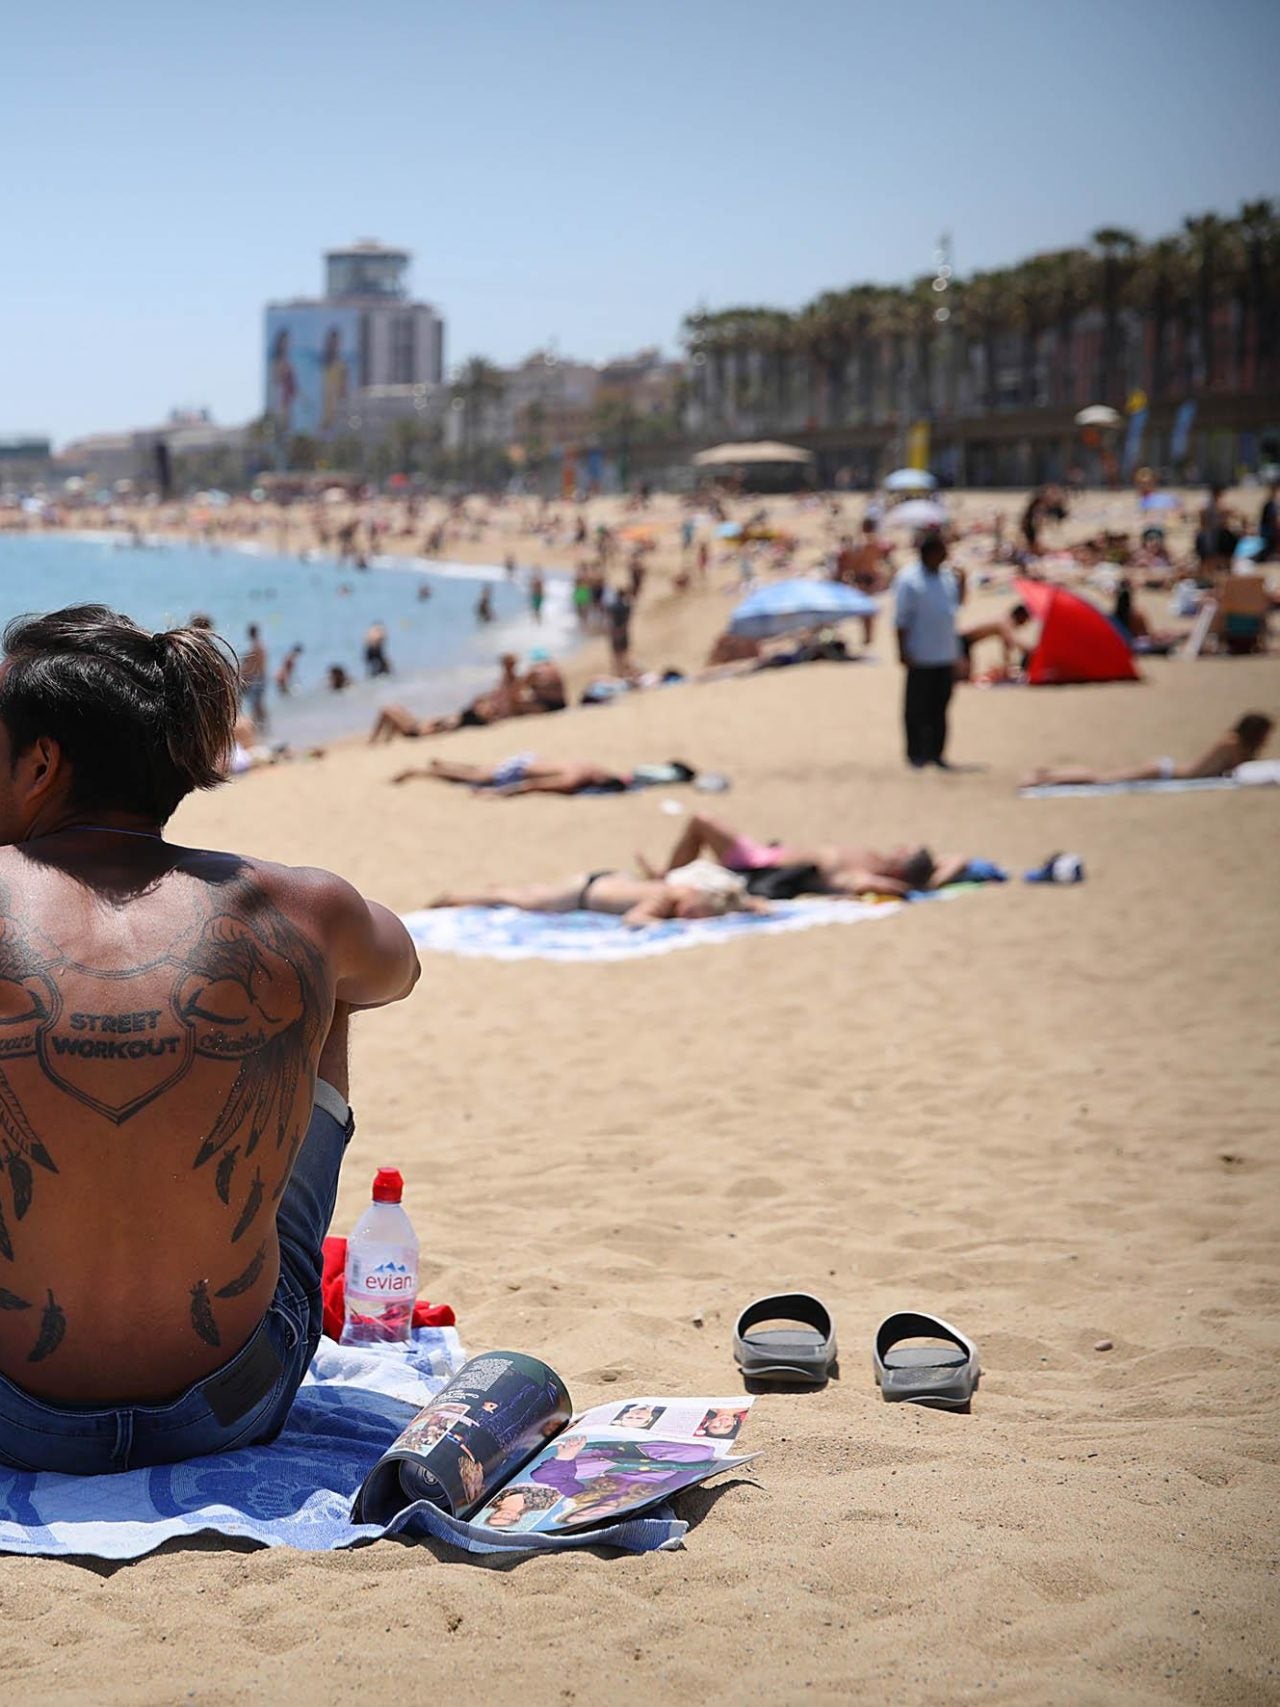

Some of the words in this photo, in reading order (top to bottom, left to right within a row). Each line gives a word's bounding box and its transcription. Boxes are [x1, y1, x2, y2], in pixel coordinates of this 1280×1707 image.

[70, 1009, 162, 1033] STREET
[51, 1036, 180, 1058] WORKOUT
[365, 1274, 412, 1290] evian
